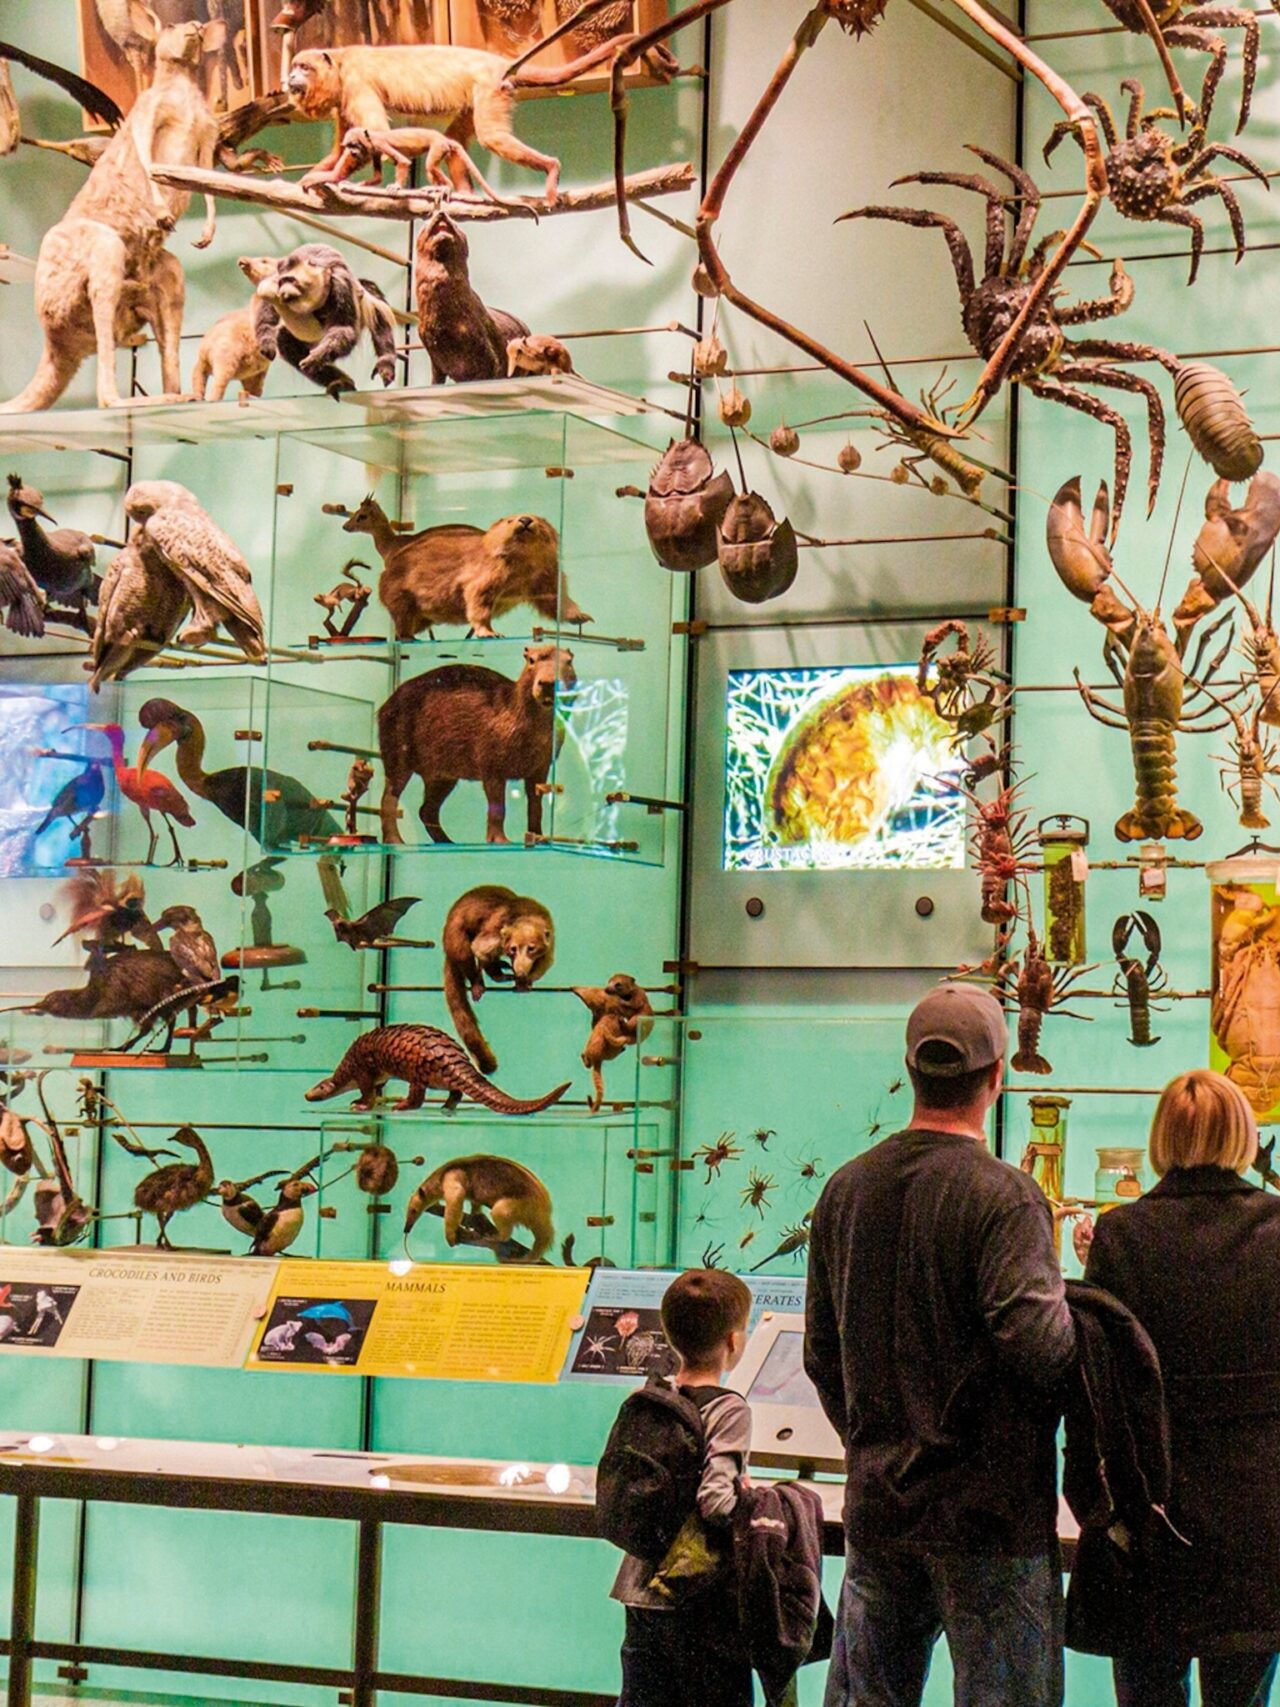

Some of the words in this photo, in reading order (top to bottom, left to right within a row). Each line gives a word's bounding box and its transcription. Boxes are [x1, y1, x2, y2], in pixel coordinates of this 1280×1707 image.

[89, 1267, 158, 1281] CROCODILES
[159, 1271, 186, 1282] AND
[188, 1273, 222, 1284] BIRDS
[384, 1281, 446, 1294] MAMMALS
[752, 1294, 803, 1306] ERATES
